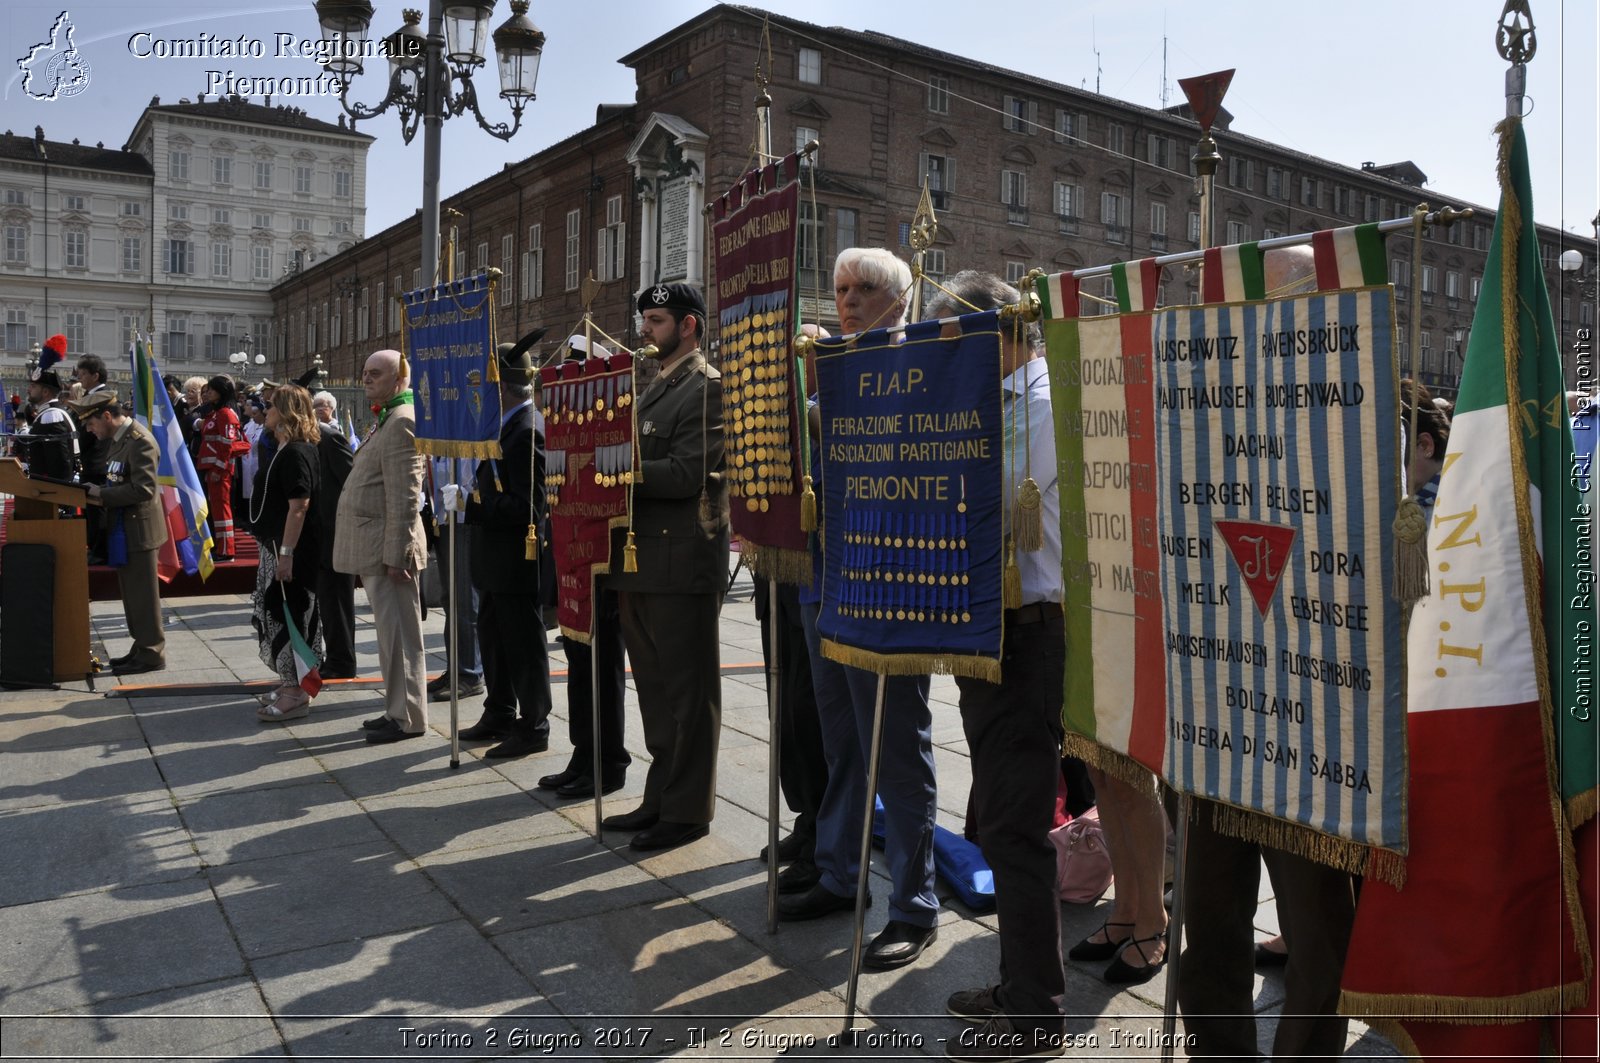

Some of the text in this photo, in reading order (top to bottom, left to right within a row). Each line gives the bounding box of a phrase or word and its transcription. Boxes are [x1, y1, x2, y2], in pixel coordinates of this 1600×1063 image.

[1157, 322, 1360, 362] AUSCHWITZ RAVENSBRÜCK
[858, 368, 927, 397] F.I.A.P.
[1265, 382, 1364, 409] BUCHENWALD
[909, 409, 982, 433] ITALIANA
[900, 438, 991, 462] PARTIGIANE
[1225, 434, 1284, 460] DACHAU
[847, 475, 949, 500] PIEMONTE
[1179, 482, 1329, 515] BERGEN BELSEN
[1161, 534, 1211, 559] GUSEN
[1311, 550, 1365, 579] DORA
[1182, 582, 1232, 606] MELK
[1291, 595, 1369, 632] EBENSEE
[1167, 631, 1371, 691] SACHSENHAUSEN FLOSSENBÜRG
[1226, 686, 1304, 724] BOLZANO
[1243, 736, 1257, 758] DI
[1264, 741, 1298, 770] SAN
[1309, 753, 1372, 794] SABBA
